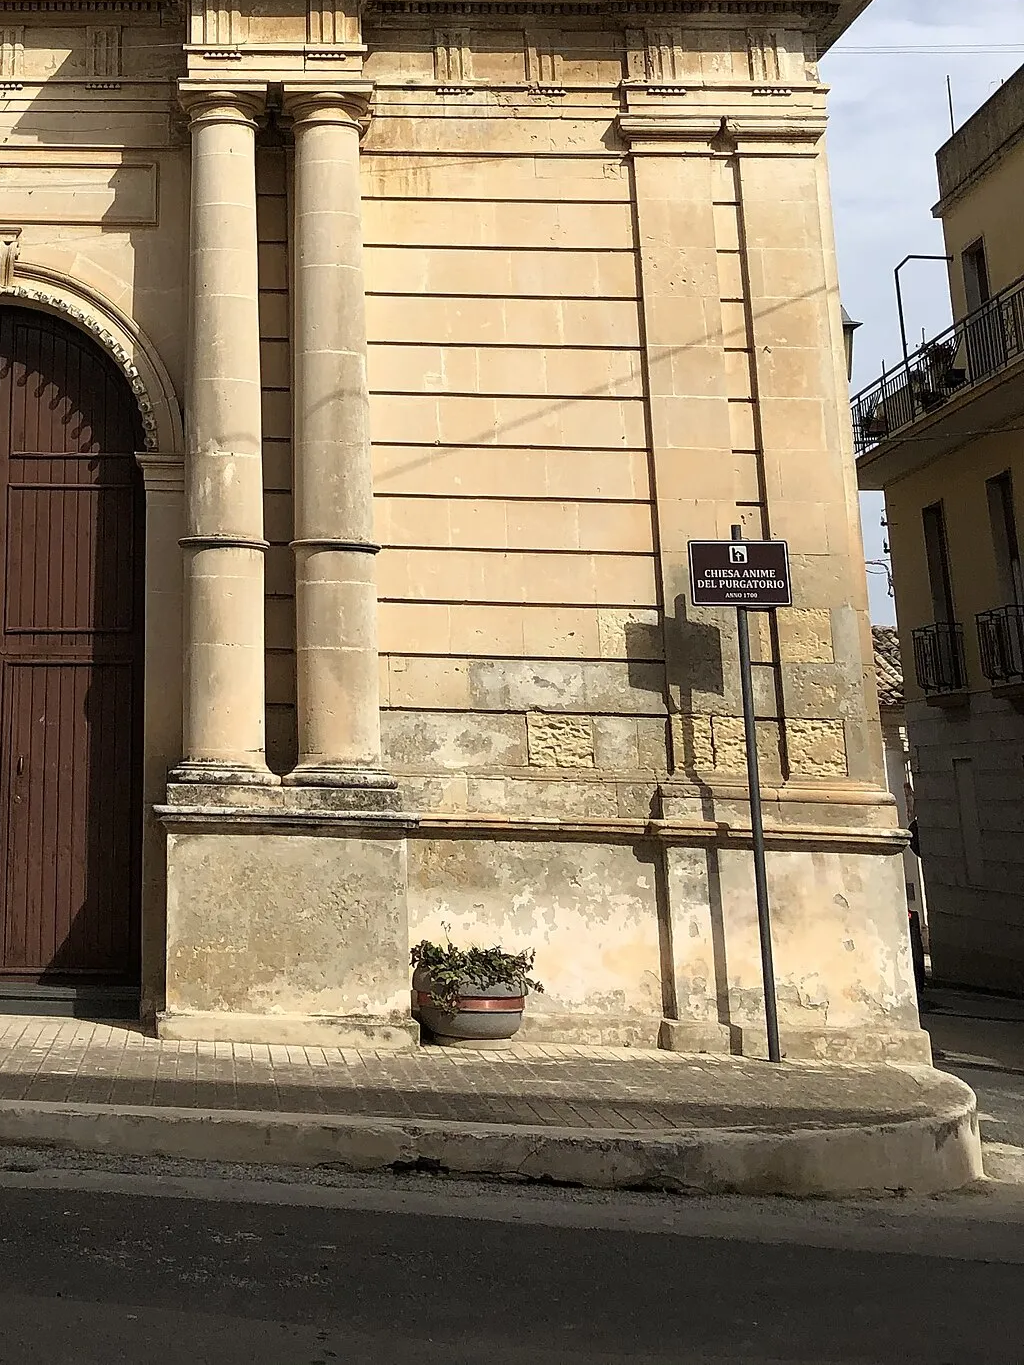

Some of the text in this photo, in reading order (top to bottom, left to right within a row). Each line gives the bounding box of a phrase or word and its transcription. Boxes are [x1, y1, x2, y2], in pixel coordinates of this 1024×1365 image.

[704, 569, 776, 578] CHIESA ANIME
[697, 579, 785, 589] DEL PURGATORIO
